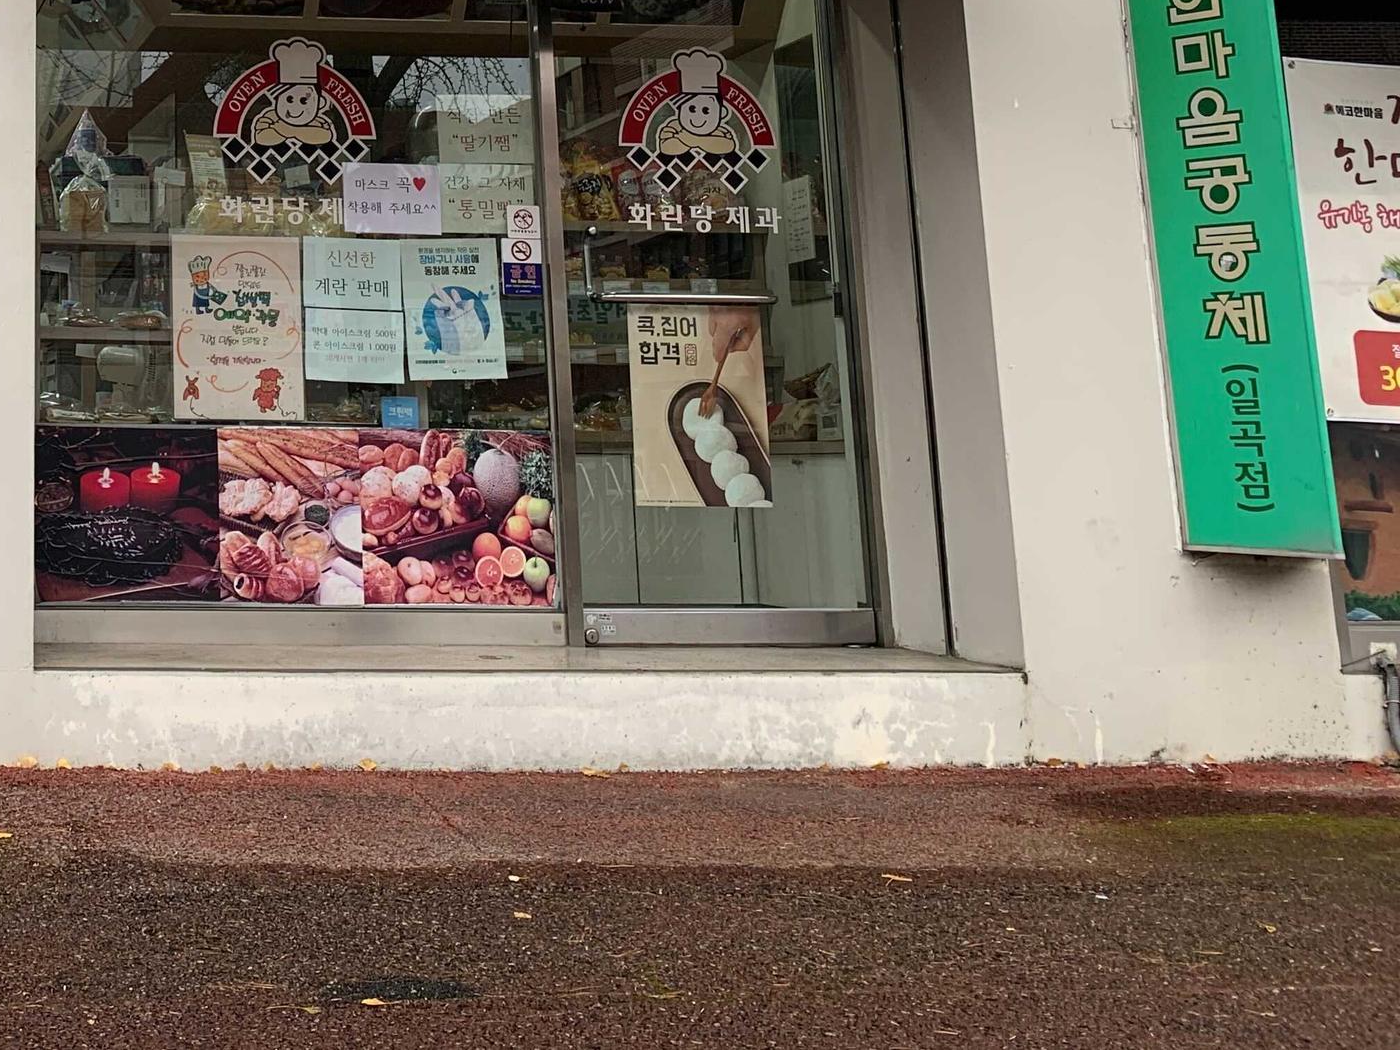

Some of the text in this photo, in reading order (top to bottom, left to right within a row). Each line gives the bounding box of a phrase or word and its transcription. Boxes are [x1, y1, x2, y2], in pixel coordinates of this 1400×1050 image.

[228, 70, 367, 128] OVEN FRESH
[633, 80, 768, 138] OVEN FRESH
[354, 176, 412, 193] 마스크 꼭
[445, 176, 470, 191] 건강
[478, 177, 493, 190] 그
[348, 201, 383, 216] 착용해
[1317, 199, 1374, 234] 유기농
[725, 205, 783, 235] 제과
[327, 249, 376, 269] 신선한
[419, 254, 479, 264] 장바구니 사용에
[452, 265, 477, 276] 주세요
[315, 278, 390, 298] 계란 판매
[638, 340, 681, 366] 합격
[1220, 363, 1276, 514] (일곡점)
